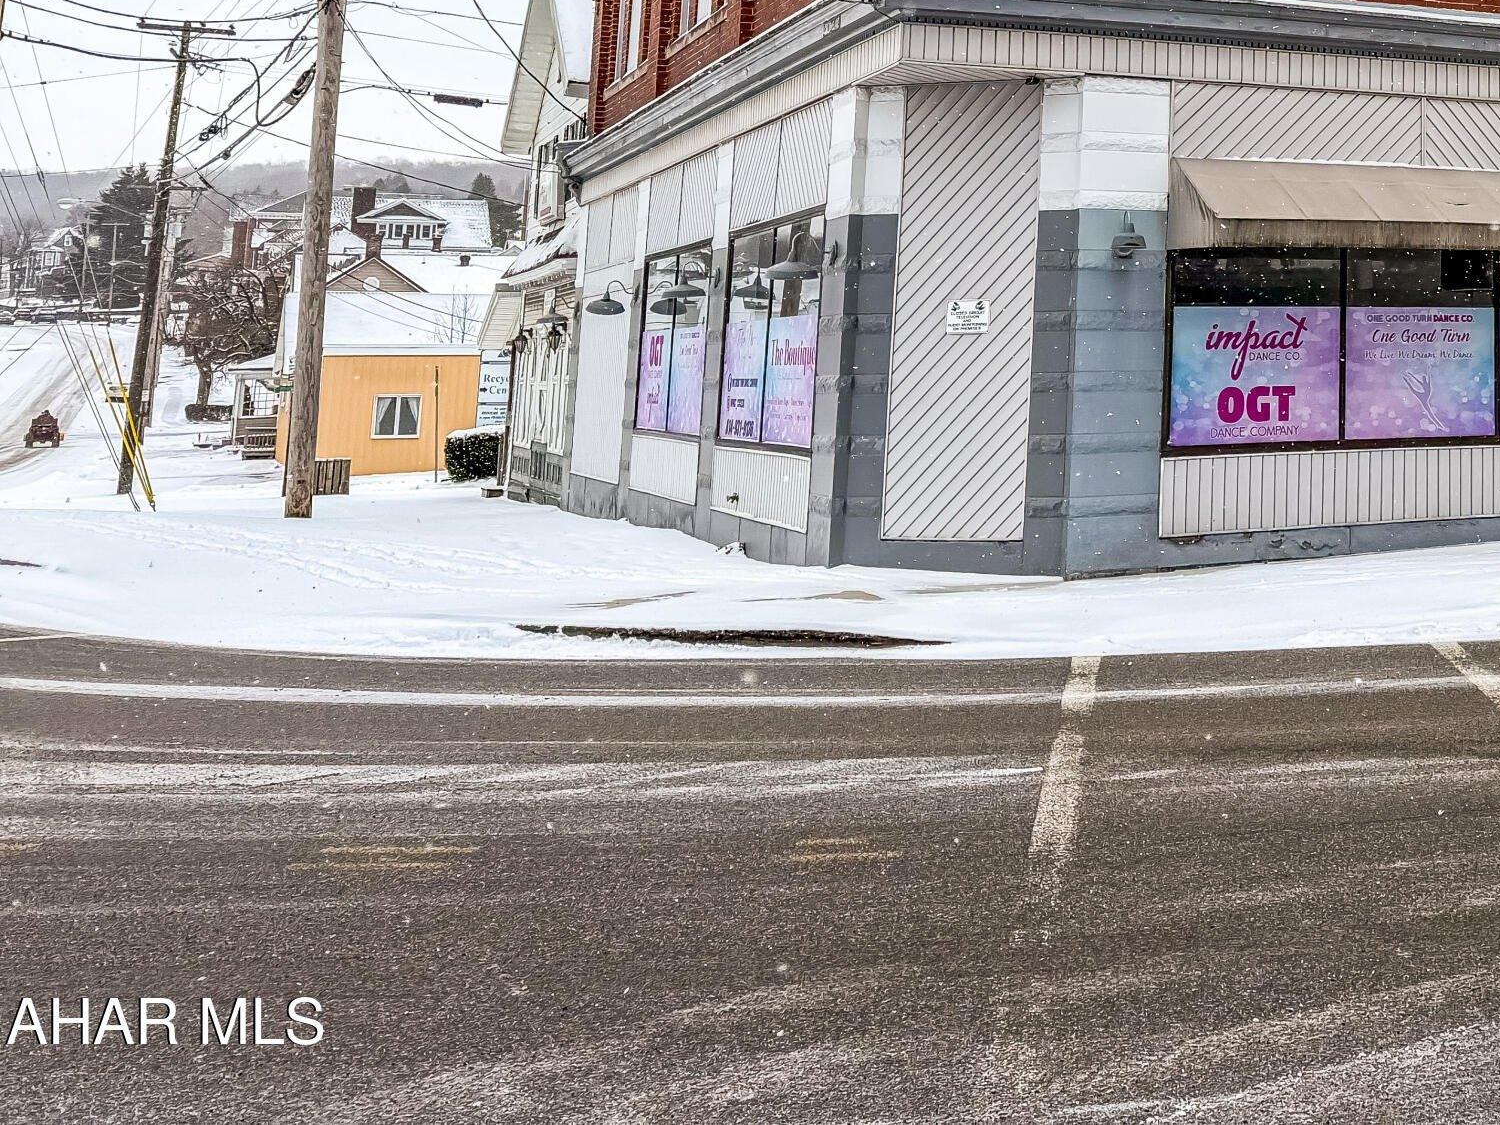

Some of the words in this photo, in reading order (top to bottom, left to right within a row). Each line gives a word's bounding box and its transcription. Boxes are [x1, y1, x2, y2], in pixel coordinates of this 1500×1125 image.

[1366, 314, 1383, 323] ONE
[1385, 314, 1410, 323] GOOD
[1412, 314, 1432, 323] TURN
[1433, 314, 1459, 323] DANCE
[1372, 329, 1397, 343] One
[1401, 329, 1436, 343] Good
[1440, 328, 1470, 343] Turn
[649, 335, 664, 367] OGT
[1205, 313, 1308, 381] impact
[1365, 350, 1377, 359] We
[1399, 350, 1410, 359] We
[1440, 350, 1451, 359] We
[771, 339, 783, 366] The
[783, 338, 816, 375] Boutique
[1249, 352, 1281, 361] DANCE
[1284, 351, 1303, 361] CO.
[1217, 386, 1296, 424] OGT
[1210, 426, 1246, 438] DANCE
[1250, 425, 1299, 437] COMPANY
